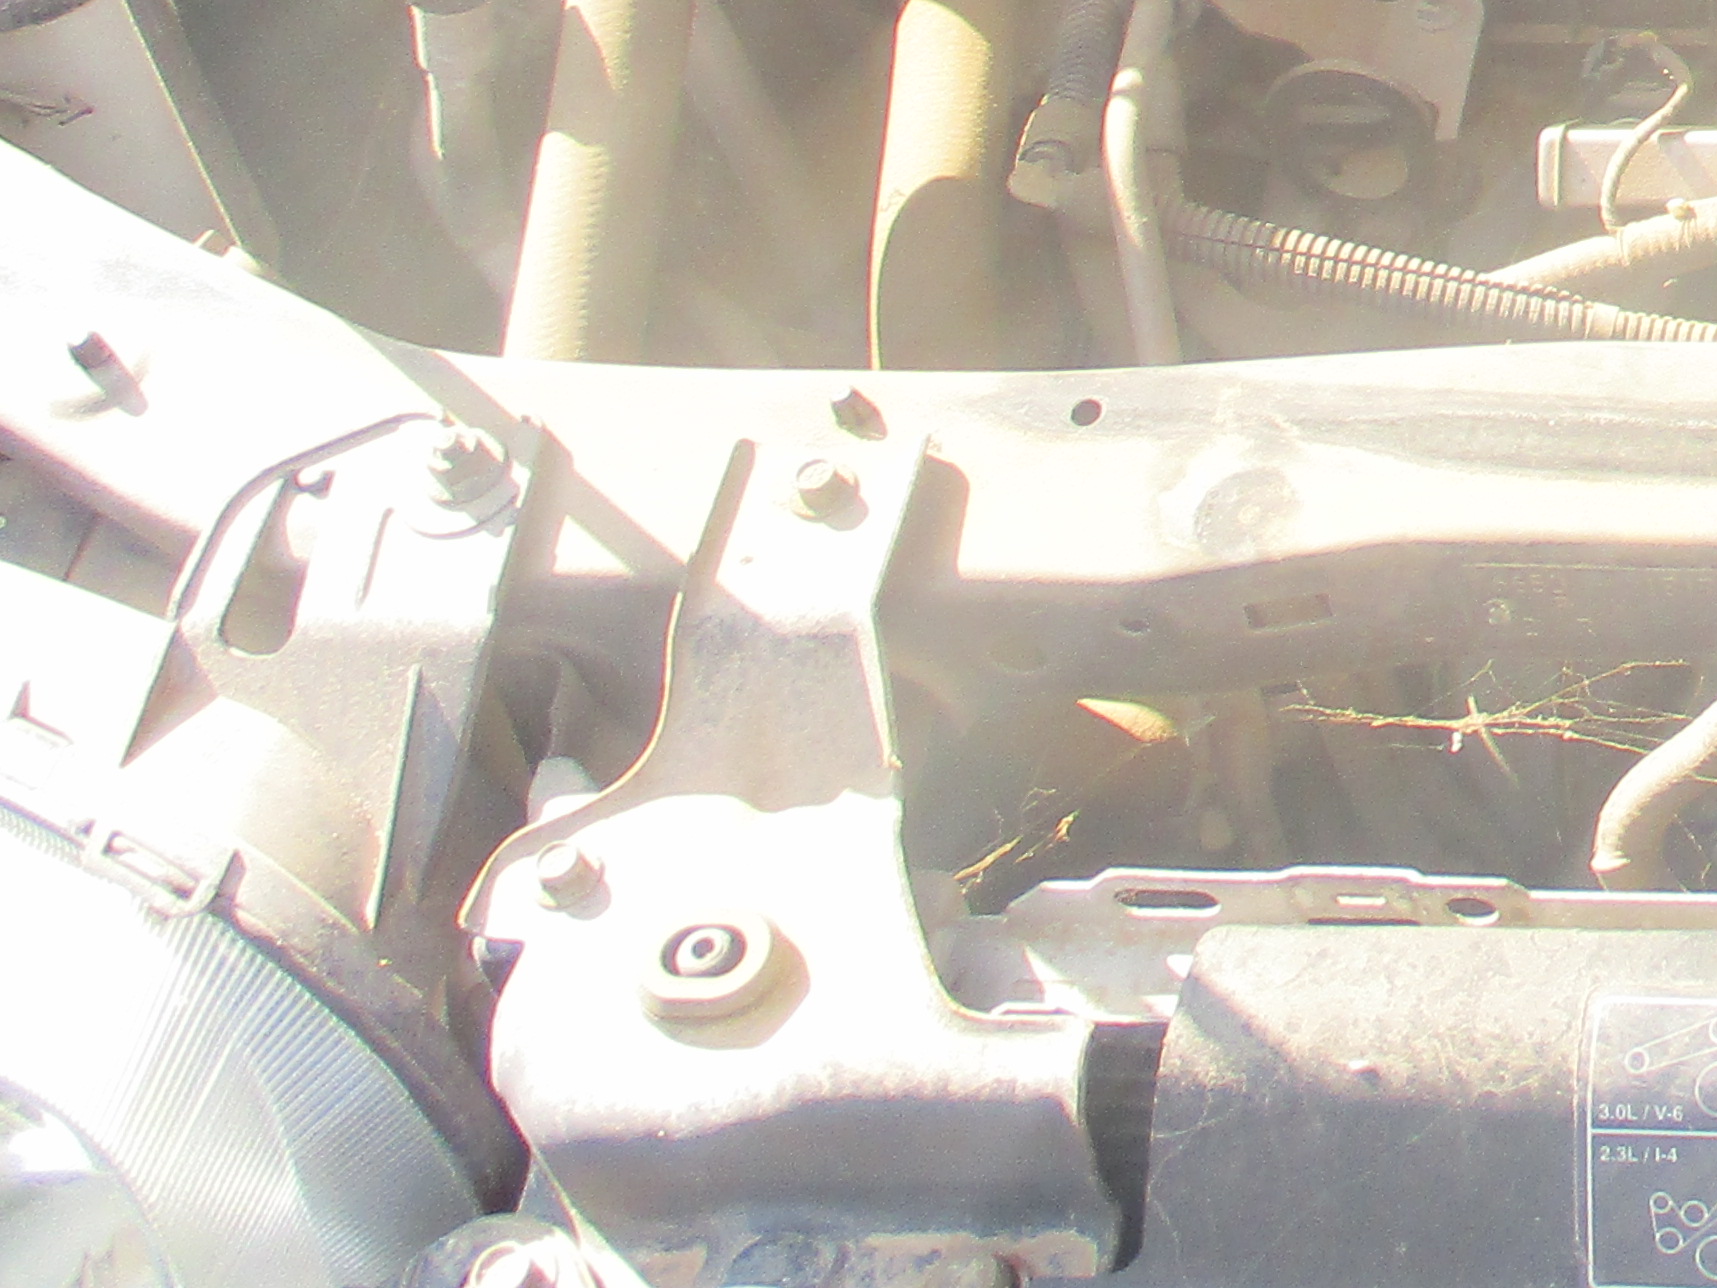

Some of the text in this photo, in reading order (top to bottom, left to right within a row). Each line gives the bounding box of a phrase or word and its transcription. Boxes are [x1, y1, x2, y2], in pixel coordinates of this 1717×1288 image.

[1599, 1104, 1639, 1121] 3.0L
[1654, 1105, 1684, 1121] V-6
[1599, 1146, 1639, 1162] 2.3L
[1655, 1146, 1679, 1163] I-4
